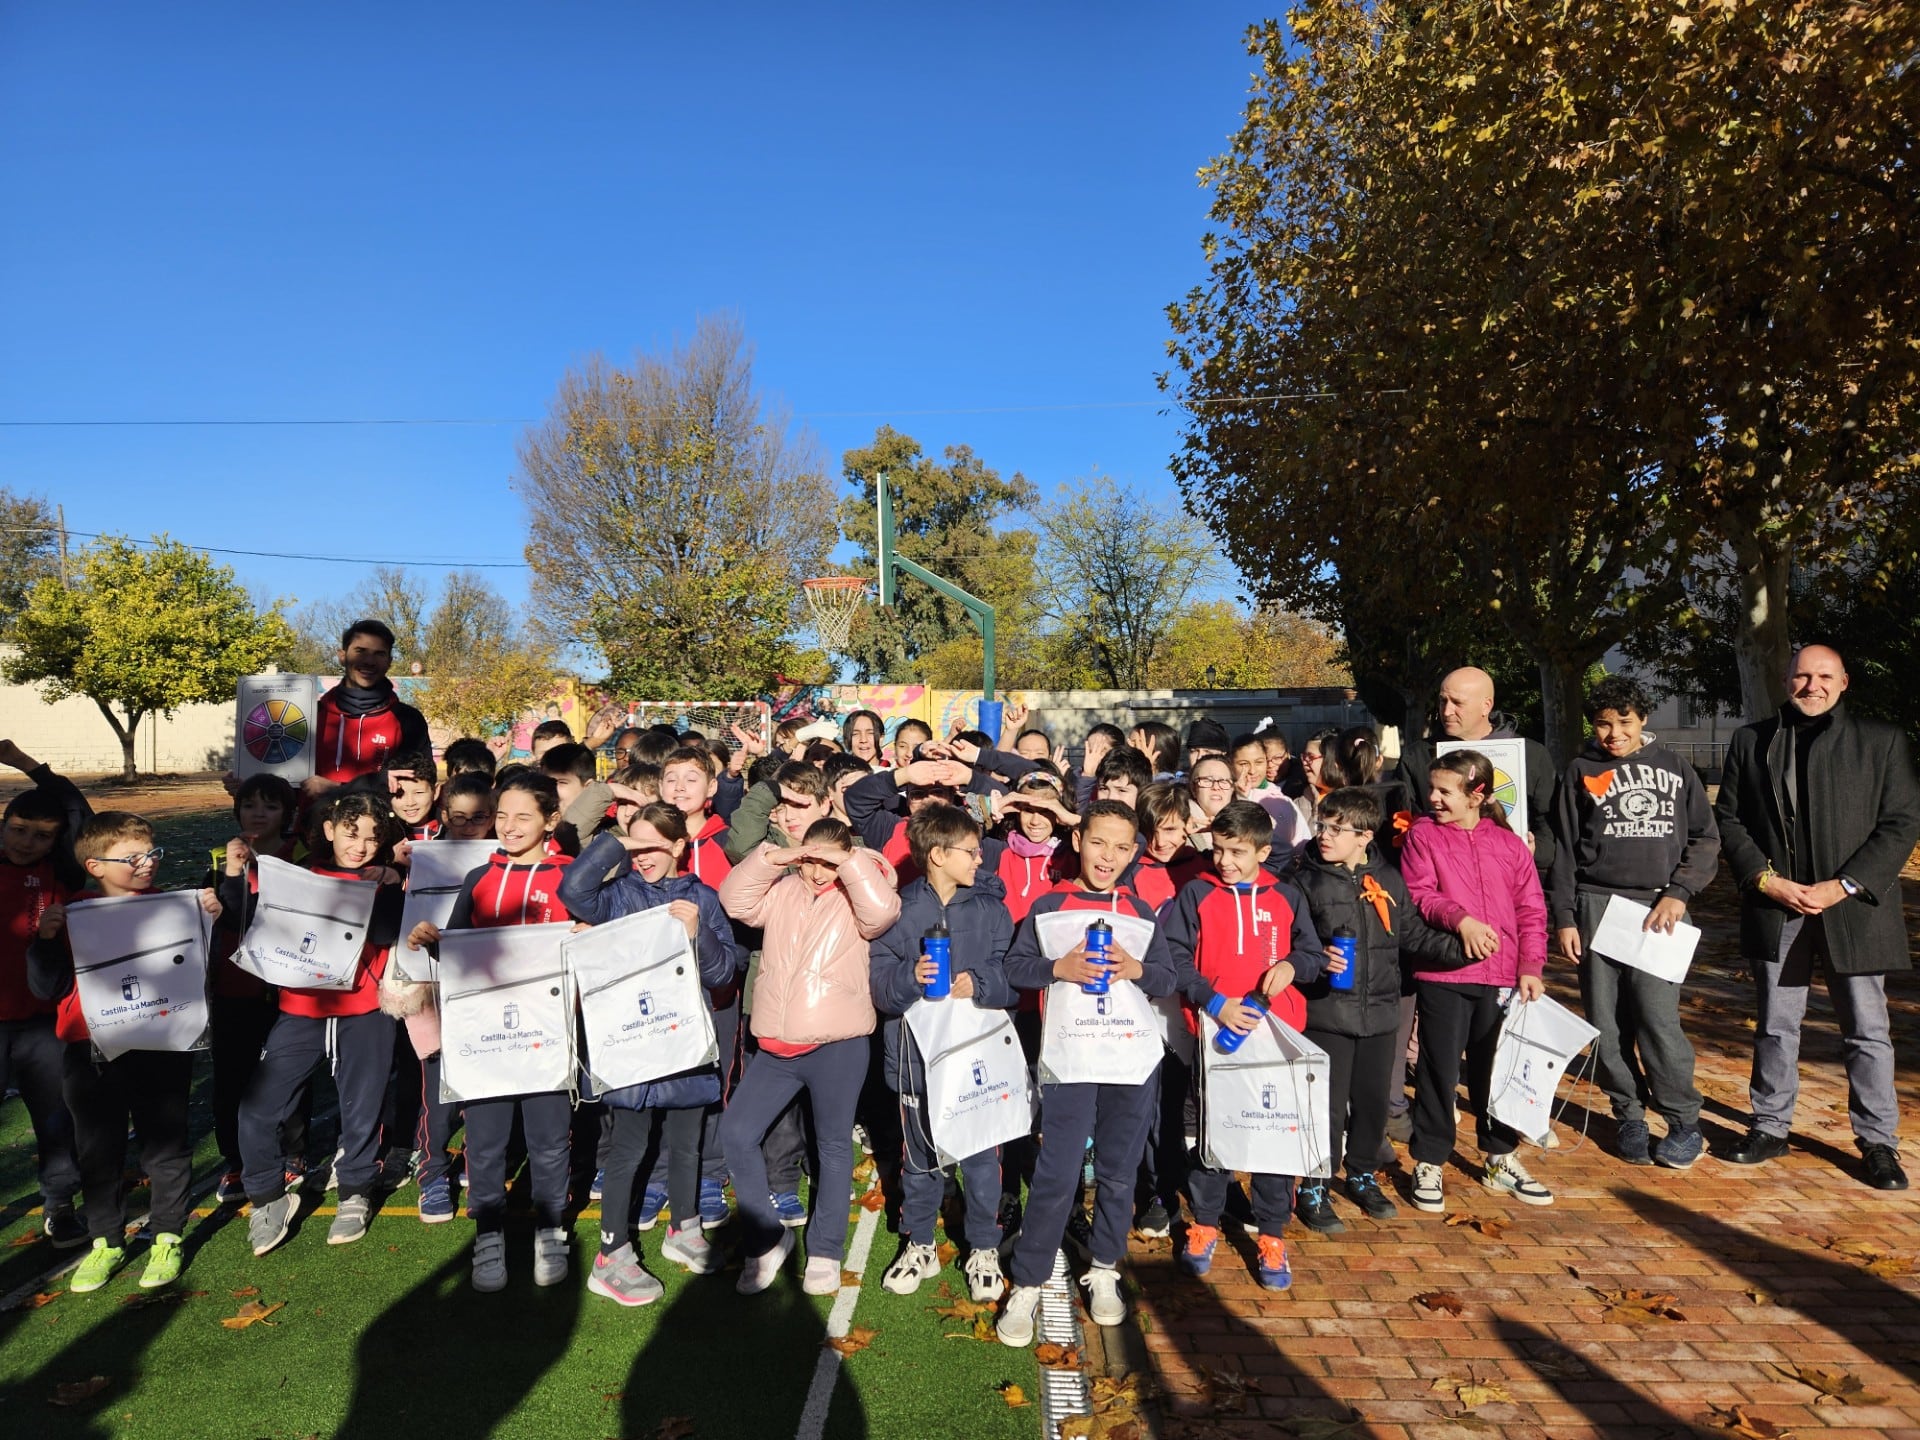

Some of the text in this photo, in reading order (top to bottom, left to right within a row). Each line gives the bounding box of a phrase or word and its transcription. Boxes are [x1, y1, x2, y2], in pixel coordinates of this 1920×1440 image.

[371, 734, 387, 744] JR
[1660, 800, 1675, 817] 13
[1603, 820, 1674, 835] ATHLETIC
[531, 889, 549, 904] JR
[1256, 908, 1272, 923] JR
[101, 997, 169, 1017] Castilla-La Mancha
[622, 1011, 677, 1032] Castilla-La Mancha
[1075, 1018, 1134, 1026] Castilla-La Mancha
[481, 1030, 543, 1042] Castilla-La Mancha
[958, 1080, 1009, 1103] Castilla-La Mancha
[1241, 1110, 1275, 1120] Castilla-La
